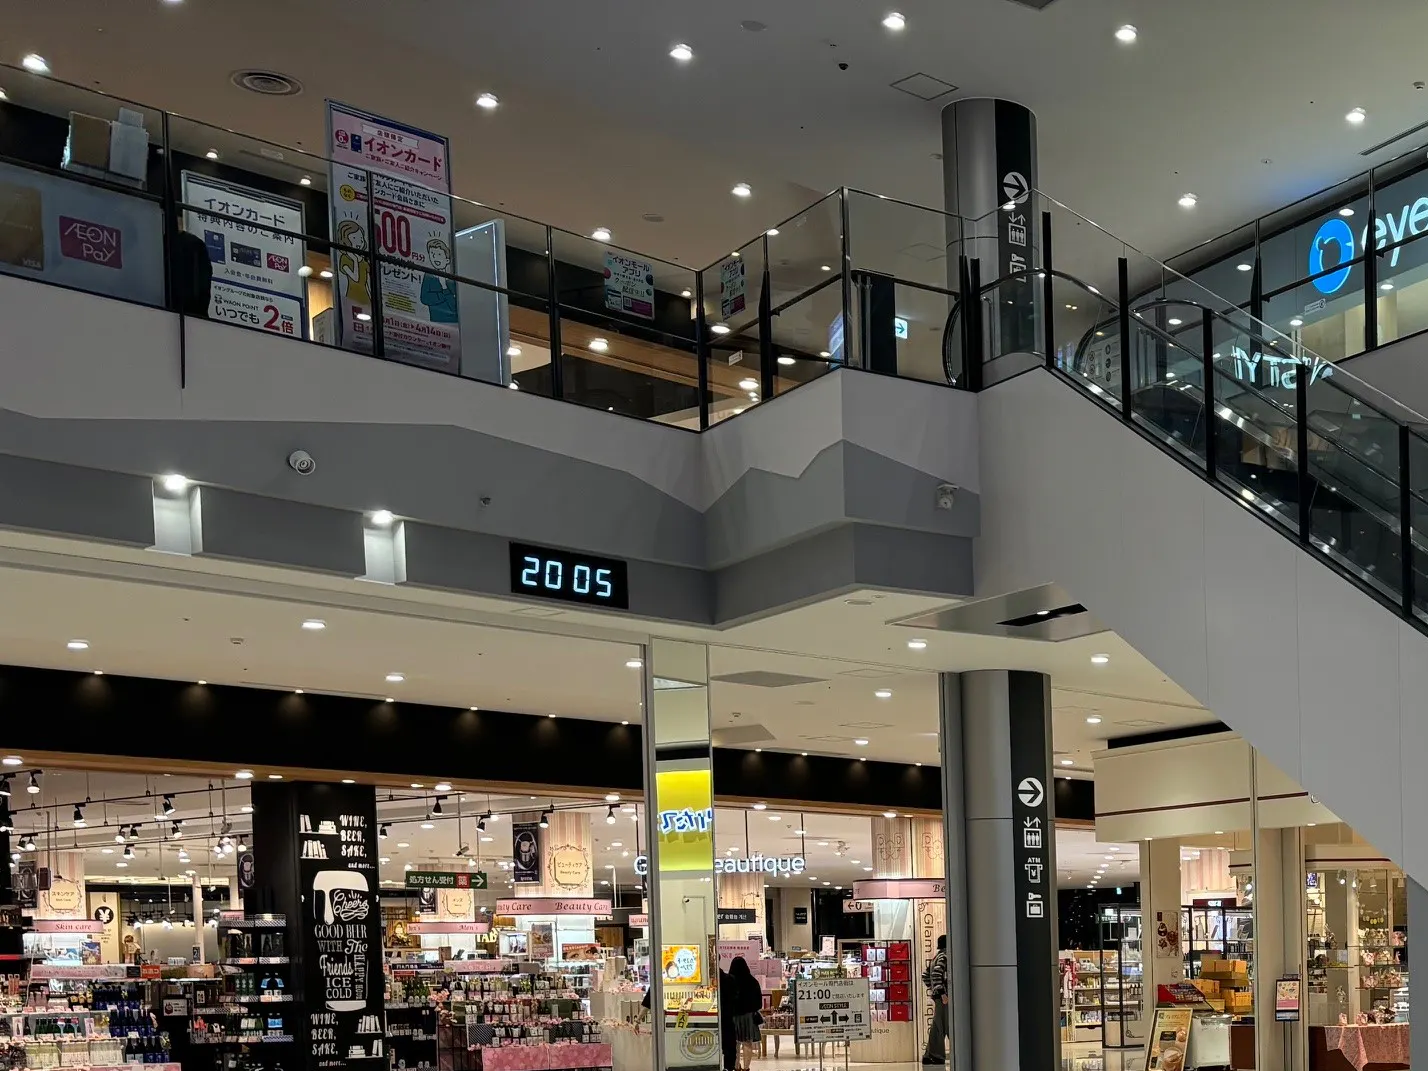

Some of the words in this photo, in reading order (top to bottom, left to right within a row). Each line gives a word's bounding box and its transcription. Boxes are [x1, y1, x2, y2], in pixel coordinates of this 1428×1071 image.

[364, 137, 443, 172] イオンカード
[204, 198, 285, 227] イオンカード
[82, 243, 116, 262] Pay
[612, 255, 650, 272] イオンモール
[622, 265, 641, 278] アプリ
[215, 305, 260, 325] いつでも
[714, 853, 806, 878] eautique
[409, 875, 454, 885] 処方せん受付
[511, 902, 532, 911] Care
[554, 902, 592, 912] Beauty
[55, 922, 73, 930] Skin
[314, 924, 343, 938] GOOD
[346, 924, 367, 939] BEER
[924, 913, 934, 953] Glam
[317, 940, 342, 952] WITH
[344, 938, 368, 954] The
[319, 954, 354, 976] Friends
[326, 977, 352, 988] ICE
[326, 988, 352, 999] COLD
[798, 989, 831, 1000] 21:00
